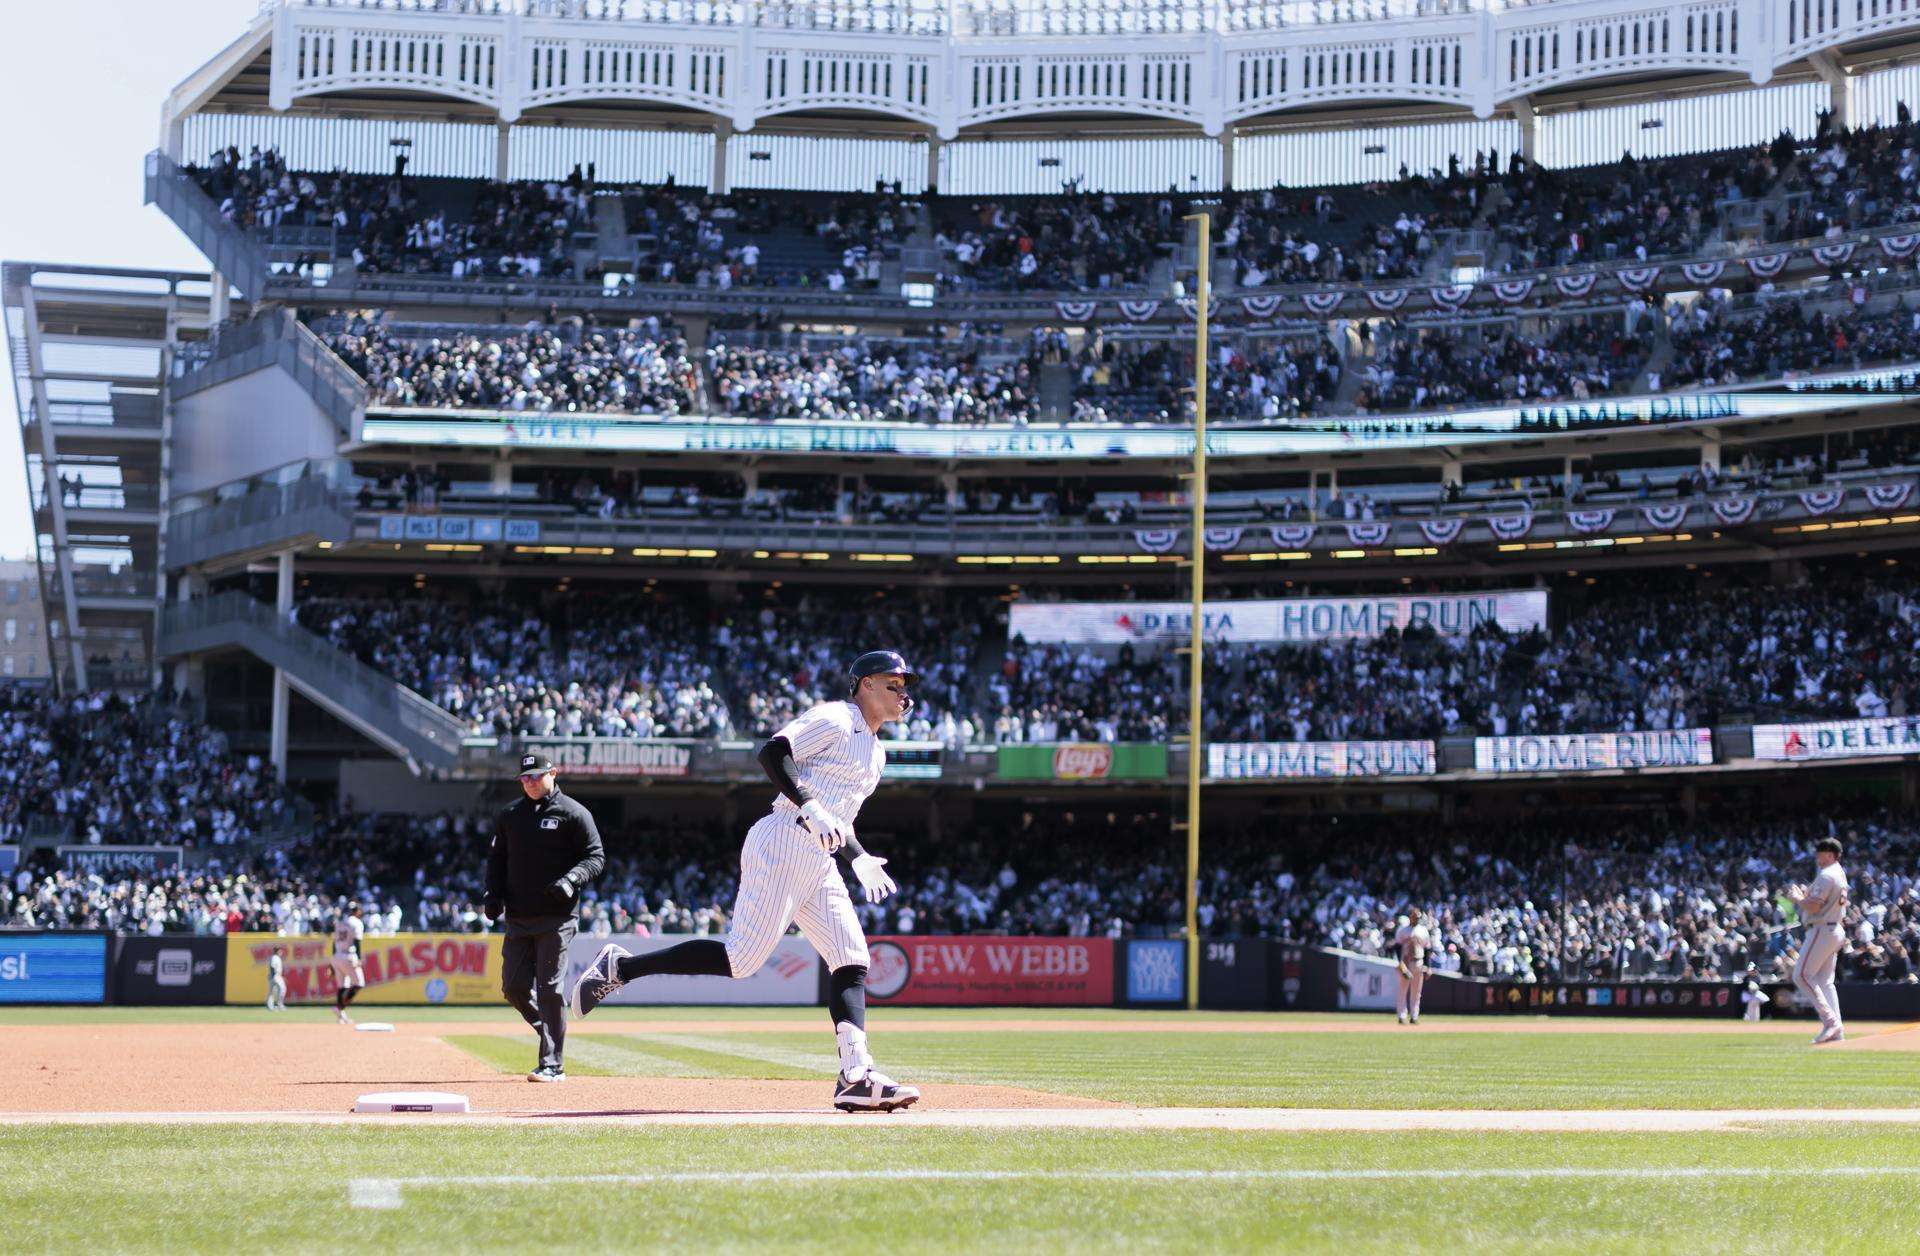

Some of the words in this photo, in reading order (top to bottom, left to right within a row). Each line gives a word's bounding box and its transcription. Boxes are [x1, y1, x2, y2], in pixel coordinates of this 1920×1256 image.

[1143, 613, 1234, 630] DELTA
[1283, 602, 1397, 635] HOME
[1410, 599, 1497, 632] RUN
[1492, 738, 1606, 770] HOME
[1616, 733, 1699, 766] RUN
[1817, 723, 1920, 750] DELTA
[587, 743, 691, 767] Authority
[1223, 745, 1334, 776] HOME
[1346, 743, 1426, 774] RUN
[985, 945, 1090, 976] WEBB
[1136, 976, 1174, 994] LIFE
